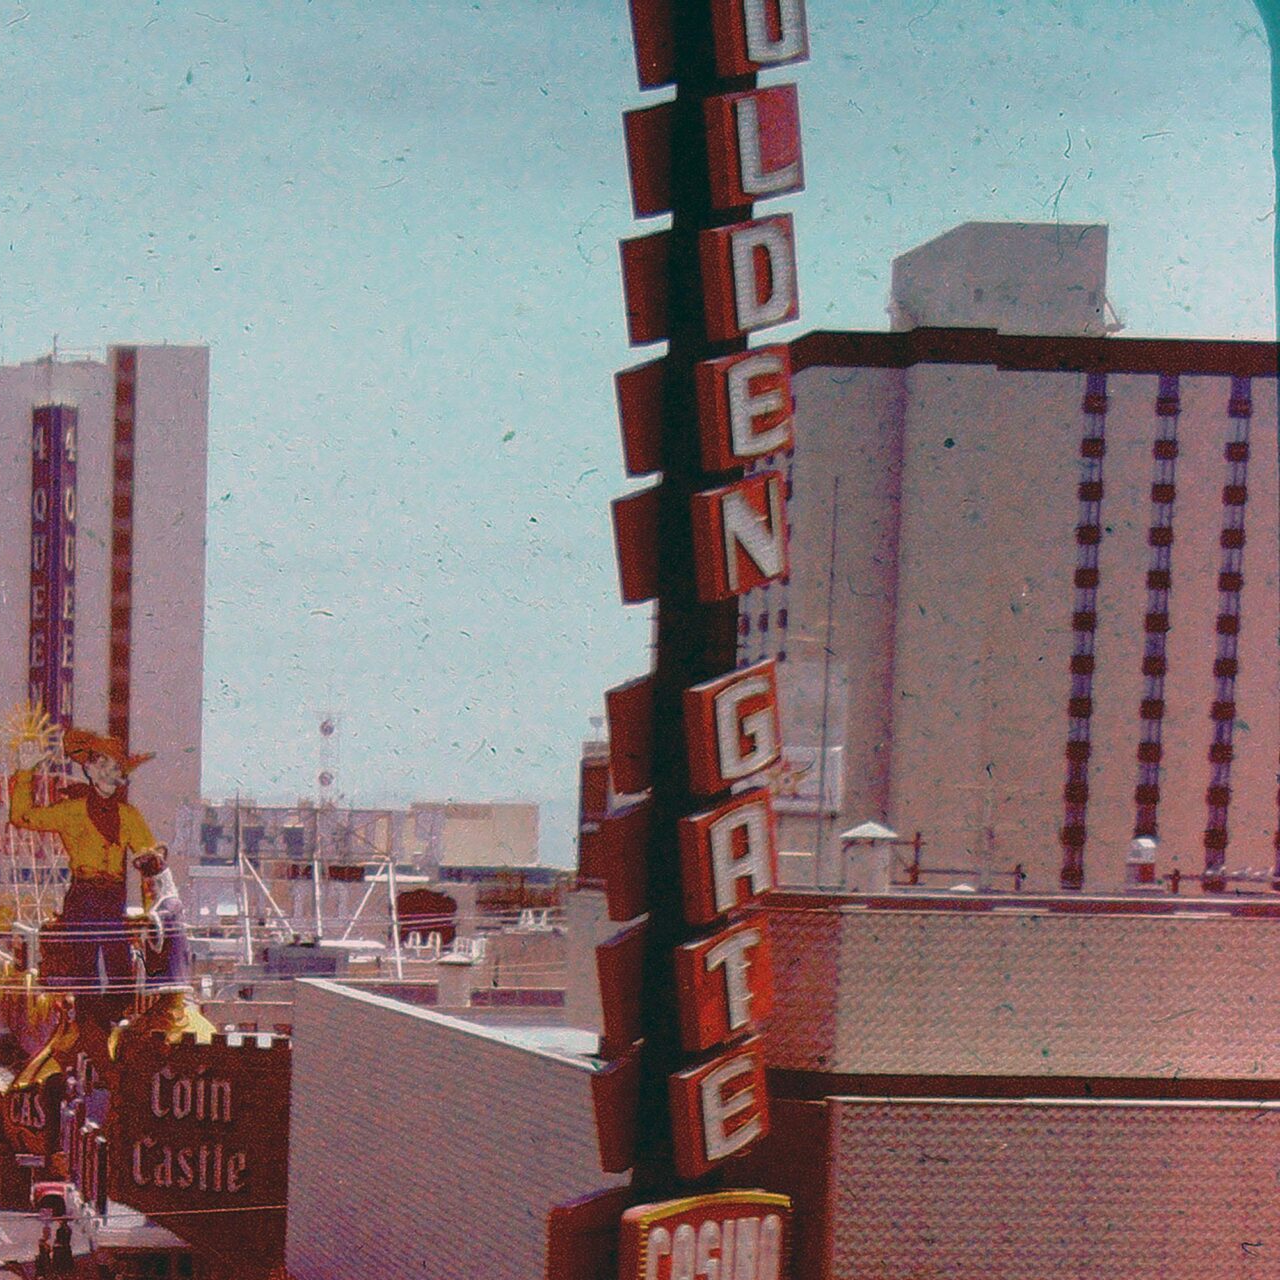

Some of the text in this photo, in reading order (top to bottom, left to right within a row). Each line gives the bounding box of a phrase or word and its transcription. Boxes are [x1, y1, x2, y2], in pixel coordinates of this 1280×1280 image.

[701, 675, 777, 1161] GATE
[151, 1064, 232, 1122] Coin
[133, 1137, 248, 1192] Castle
